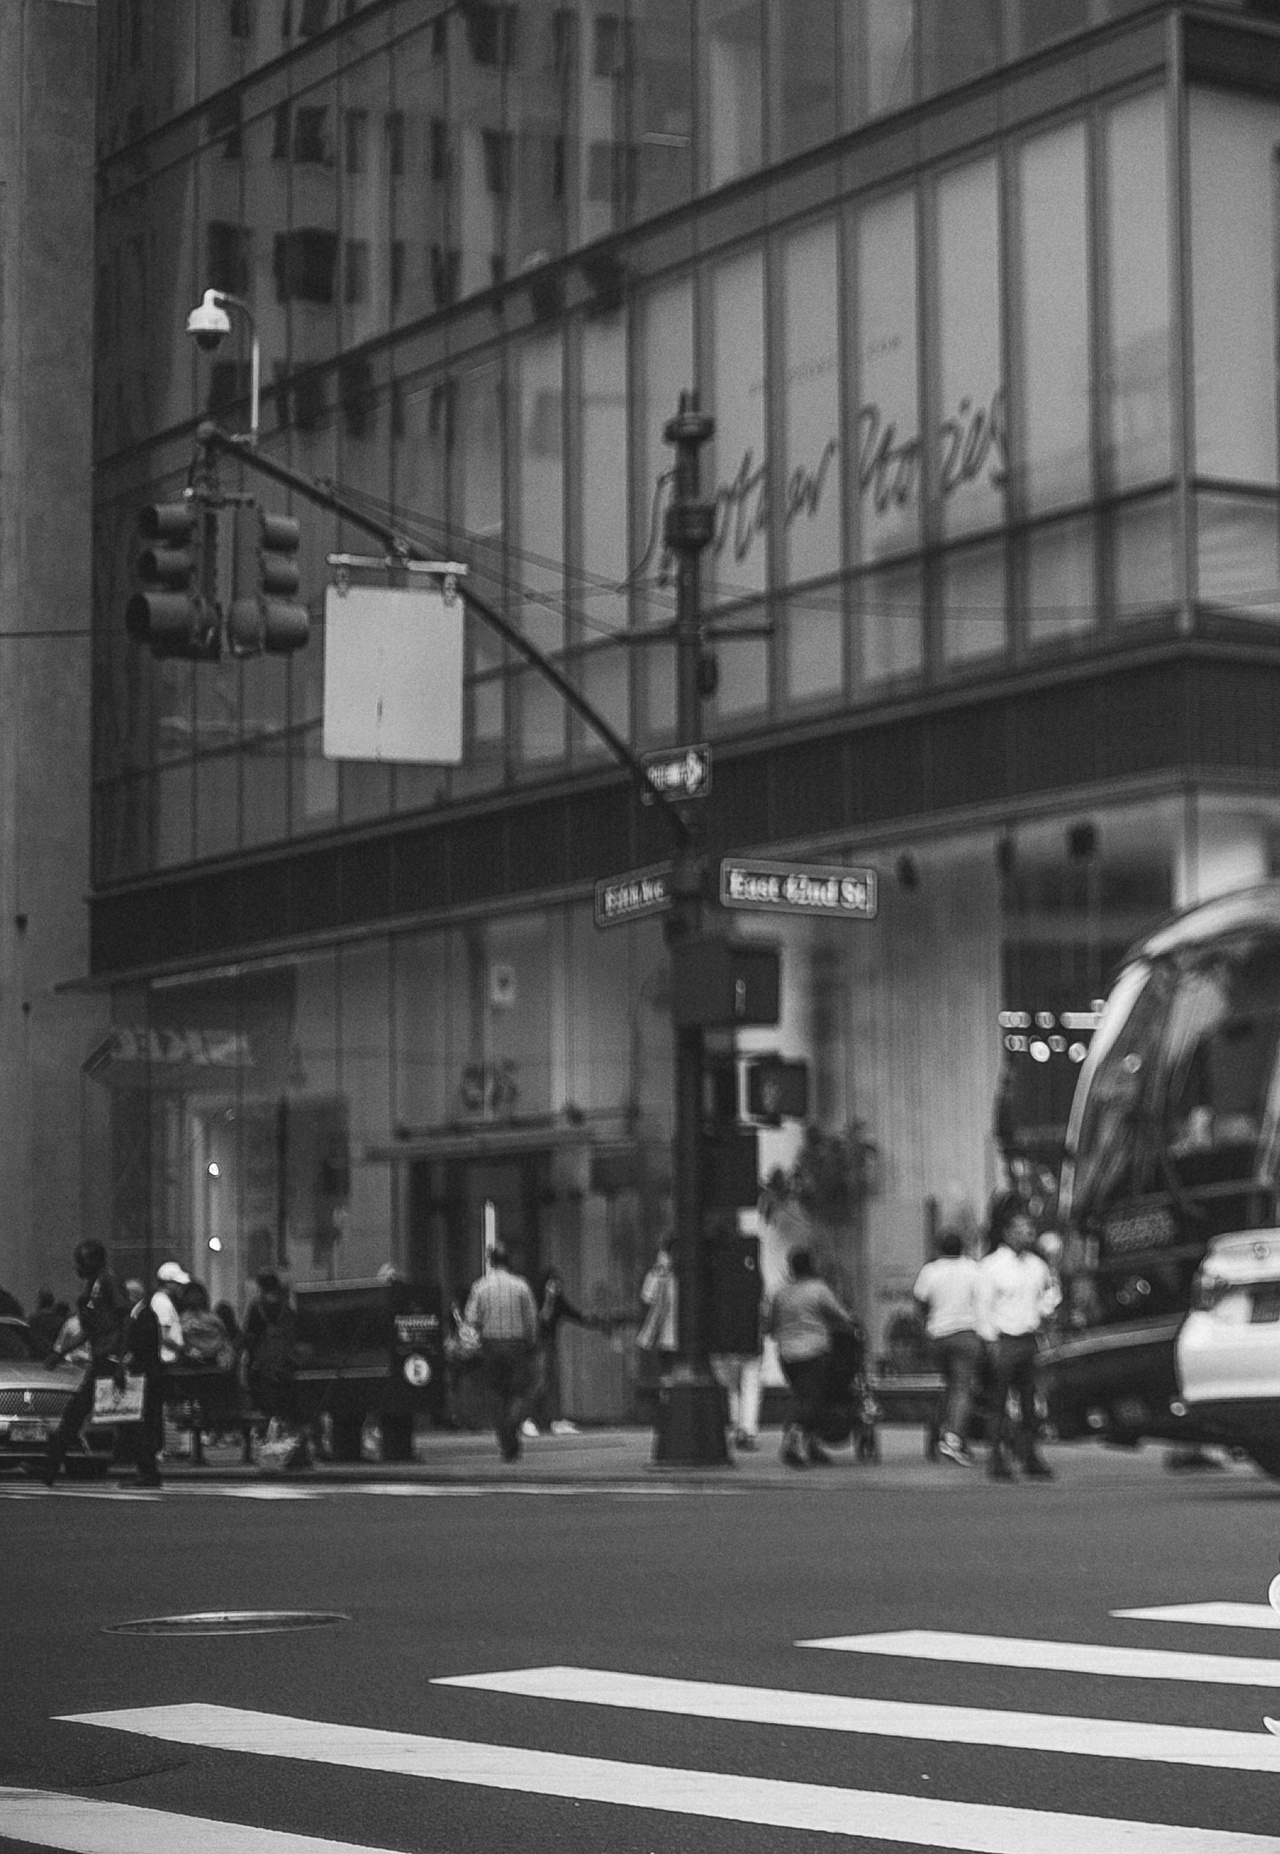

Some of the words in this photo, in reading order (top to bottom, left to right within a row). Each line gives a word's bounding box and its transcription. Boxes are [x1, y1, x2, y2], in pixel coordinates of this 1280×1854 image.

[730, 868, 779, 903] East
[783, 873, 839, 907] 42nd
[840, 876, 867, 910] St
